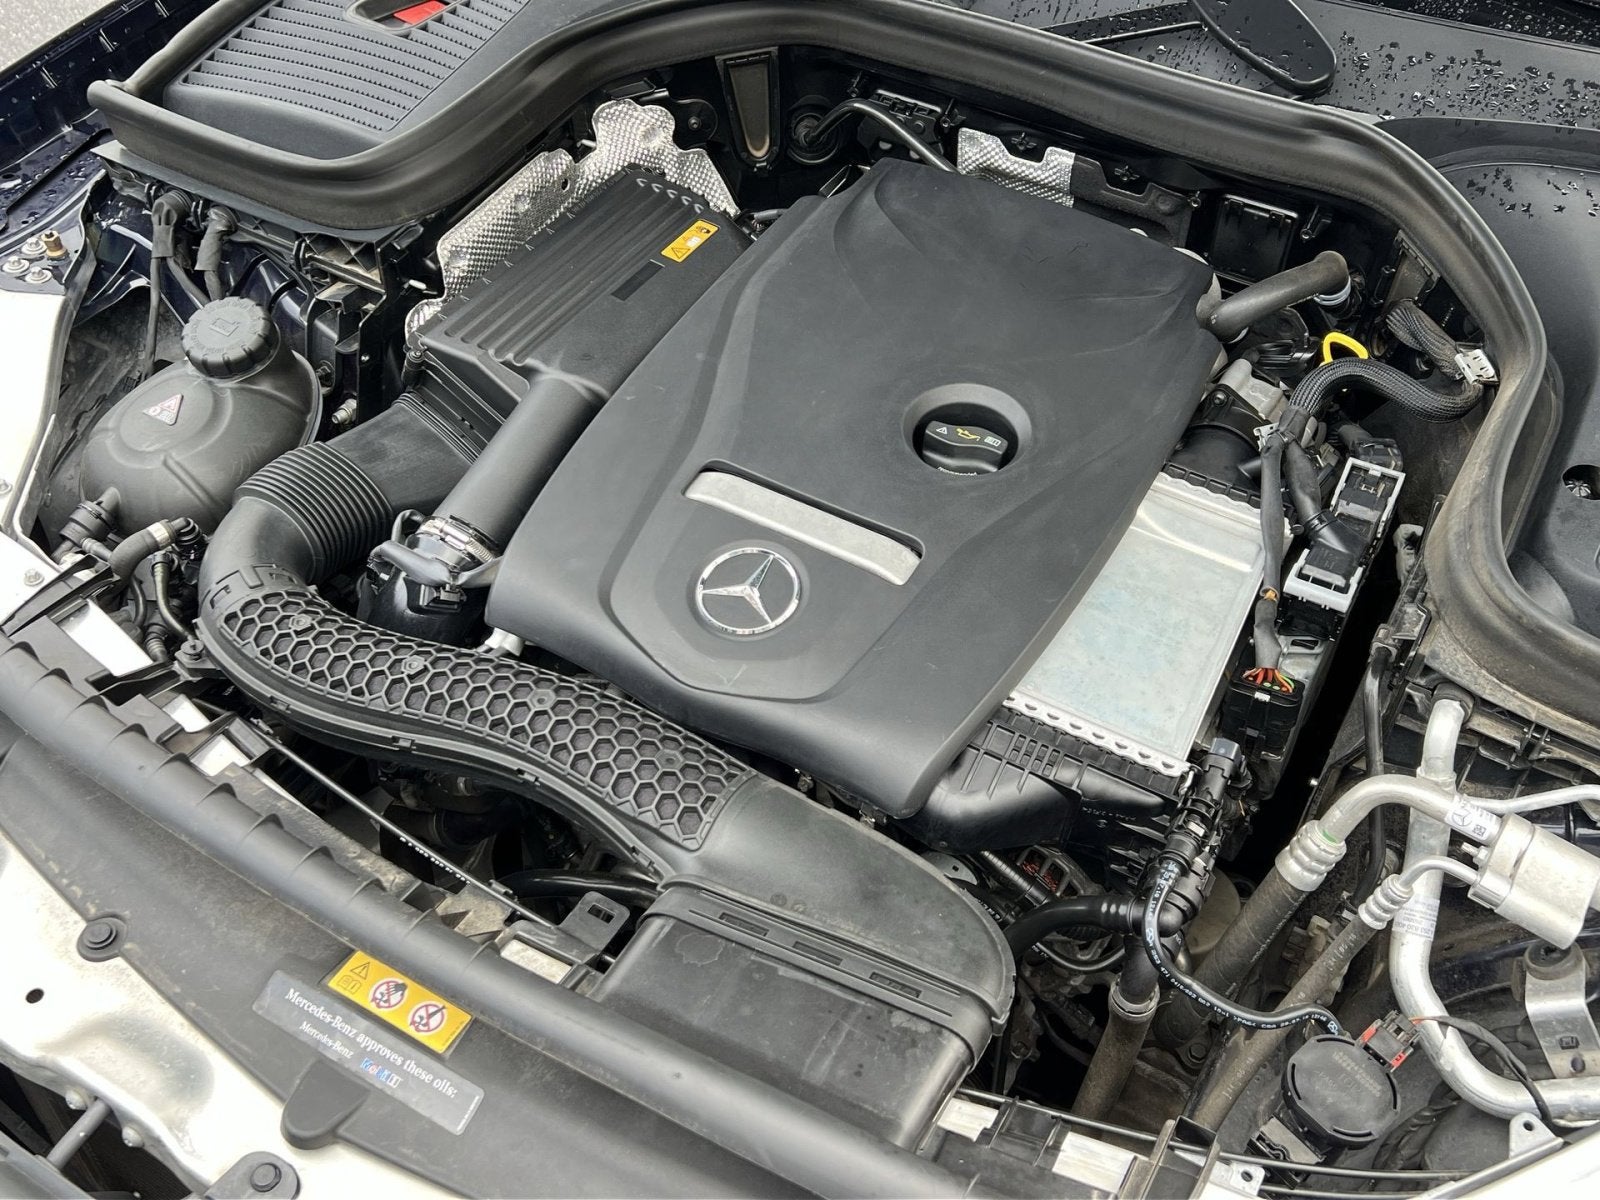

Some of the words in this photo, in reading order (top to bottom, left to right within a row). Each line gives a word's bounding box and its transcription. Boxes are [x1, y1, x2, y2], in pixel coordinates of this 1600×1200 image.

[285, 988, 357, 1038] Mercedes-Benz
[356, 1033, 404, 1066] approves
[403, 1059, 433, 1083] these
[433, 1079, 458, 1099] oils:
[299, 1020, 354, 1059] Mercedes-Benz
